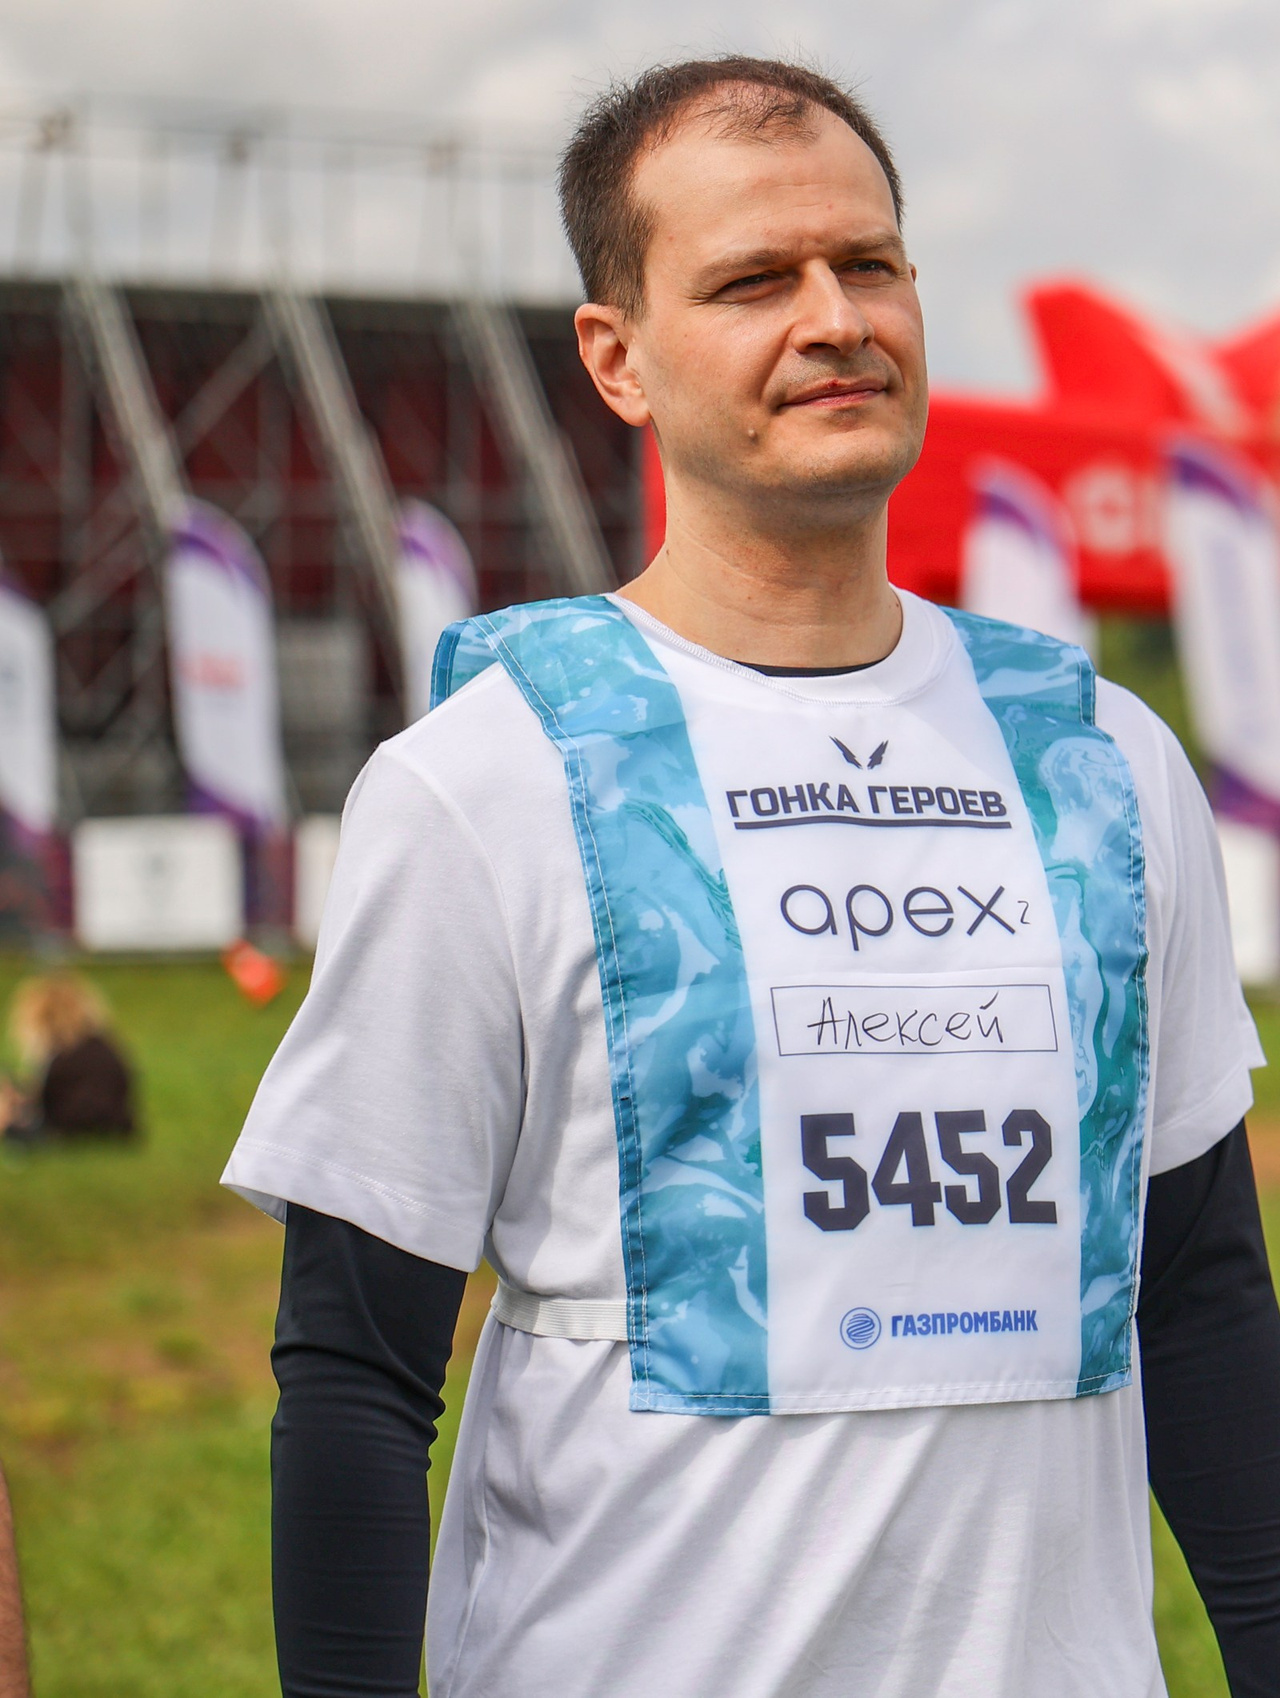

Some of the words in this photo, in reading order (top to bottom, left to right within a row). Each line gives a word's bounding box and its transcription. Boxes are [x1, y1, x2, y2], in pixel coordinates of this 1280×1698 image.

[726, 783, 860, 818] ГОНКА
[867, 785, 1007, 818] ГЕРОЕВ
[780, 883, 1016, 951] apex
[806, 990, 1004, 1050] Алексей
[800, 1109, 1058, 1232] 5452
[891, 1309, 1039, 1338] ГАЗПРОМБАНК
